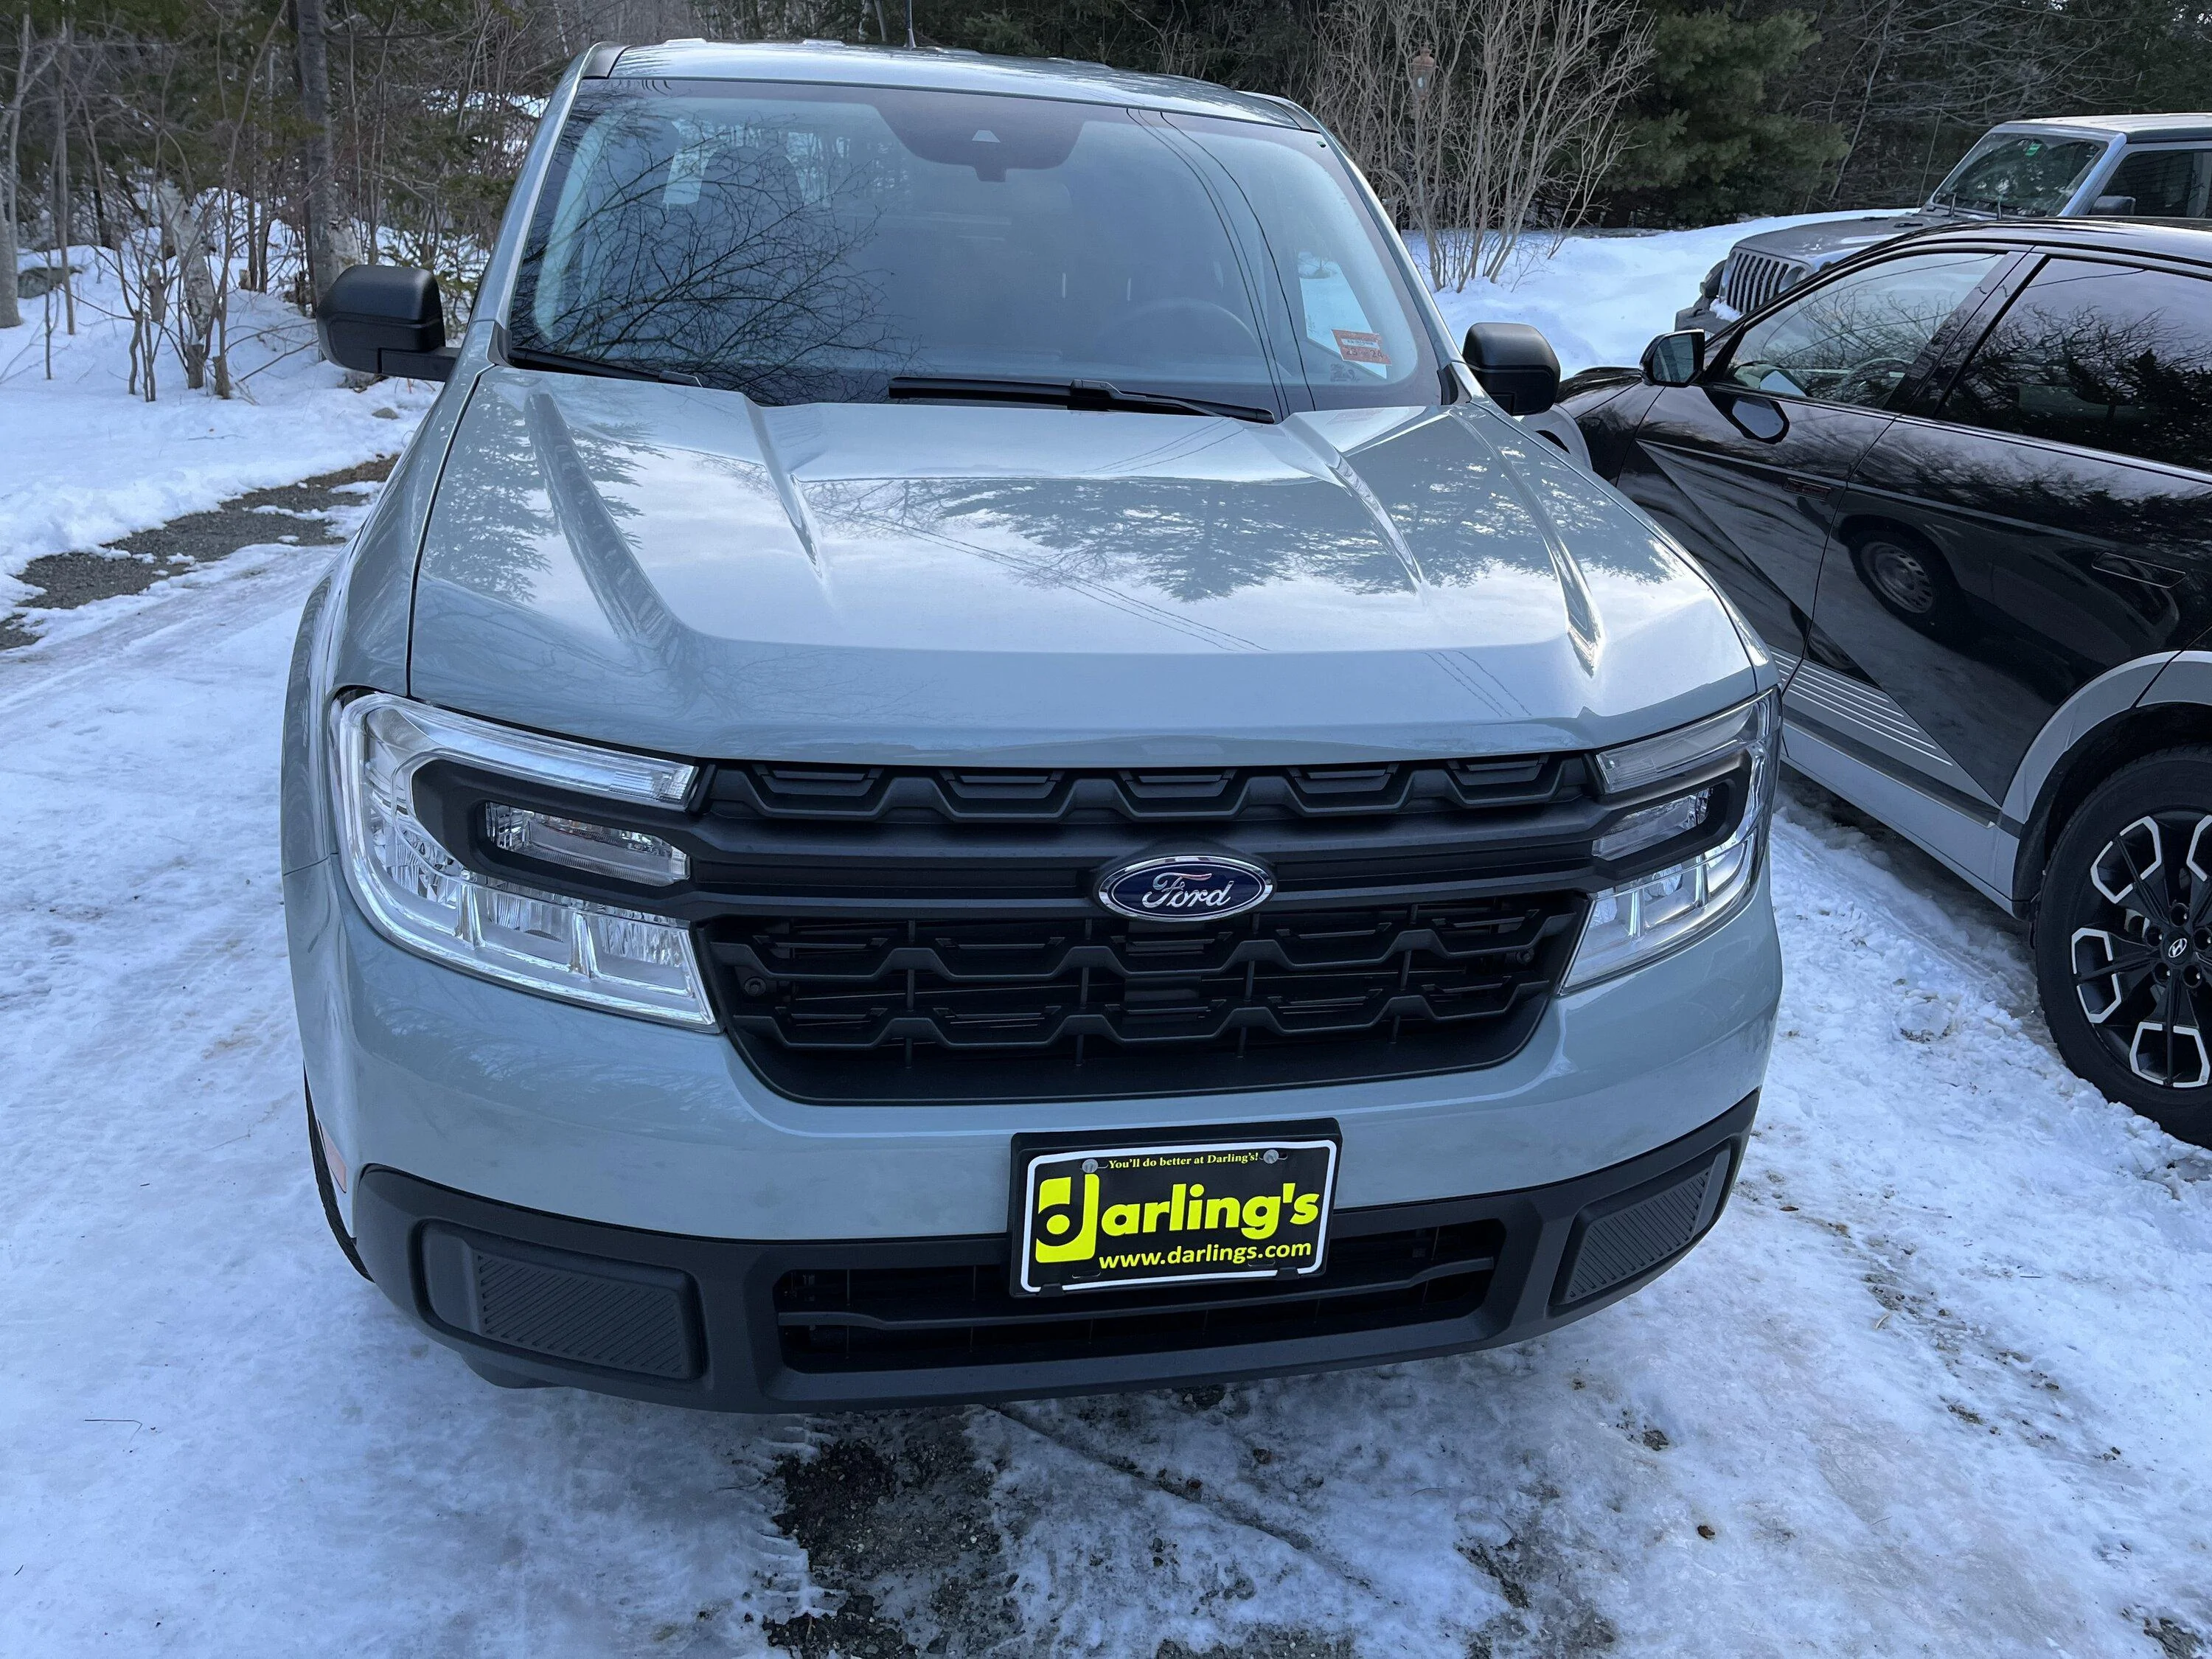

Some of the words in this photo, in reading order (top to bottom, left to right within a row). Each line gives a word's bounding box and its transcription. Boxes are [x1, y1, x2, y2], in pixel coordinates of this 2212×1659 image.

[1142, 872, 1234, 908] Ford
[1142, 1158, 1157, 1167] do
[1160, 1155, 1192, 1166] better
[1194, 1155, 1204, 1164] at
[1099, 1242, 1312, 1269] www.darlings.com
